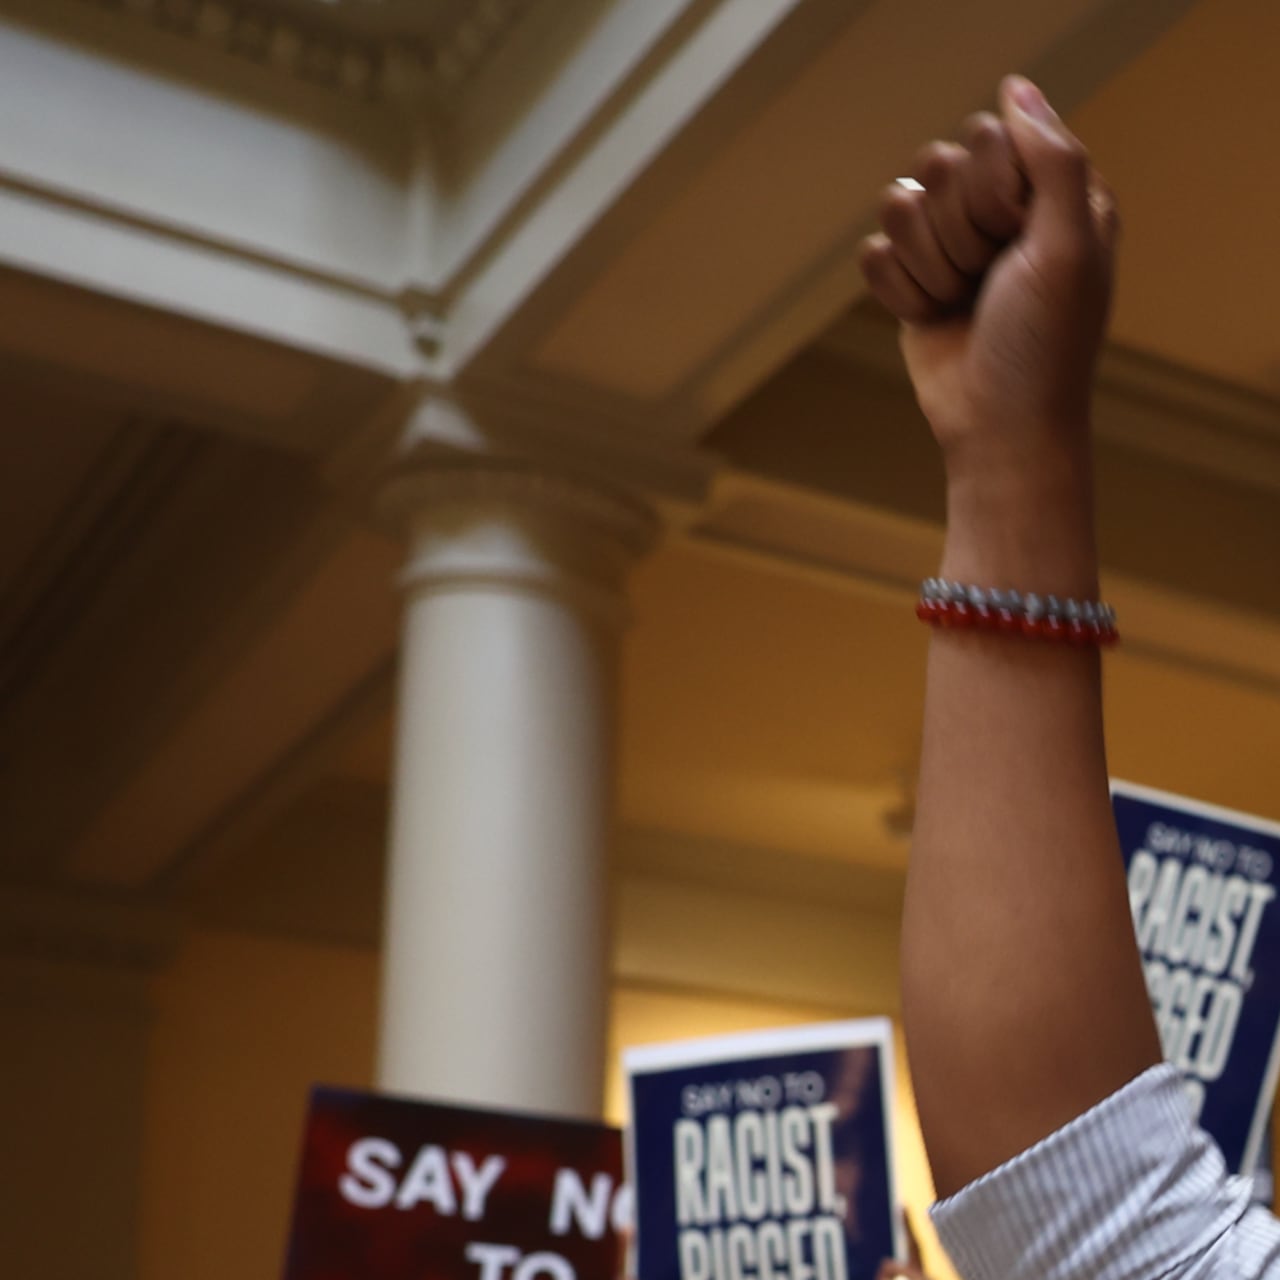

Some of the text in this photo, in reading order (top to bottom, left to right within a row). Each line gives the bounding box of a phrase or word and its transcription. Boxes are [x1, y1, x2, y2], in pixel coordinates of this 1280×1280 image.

[682, 1071, 824, 1116] SAY NO TO
[338, 1137, 506, 1221] SAY
[674, 1105, 847, 1225] RACIST,
